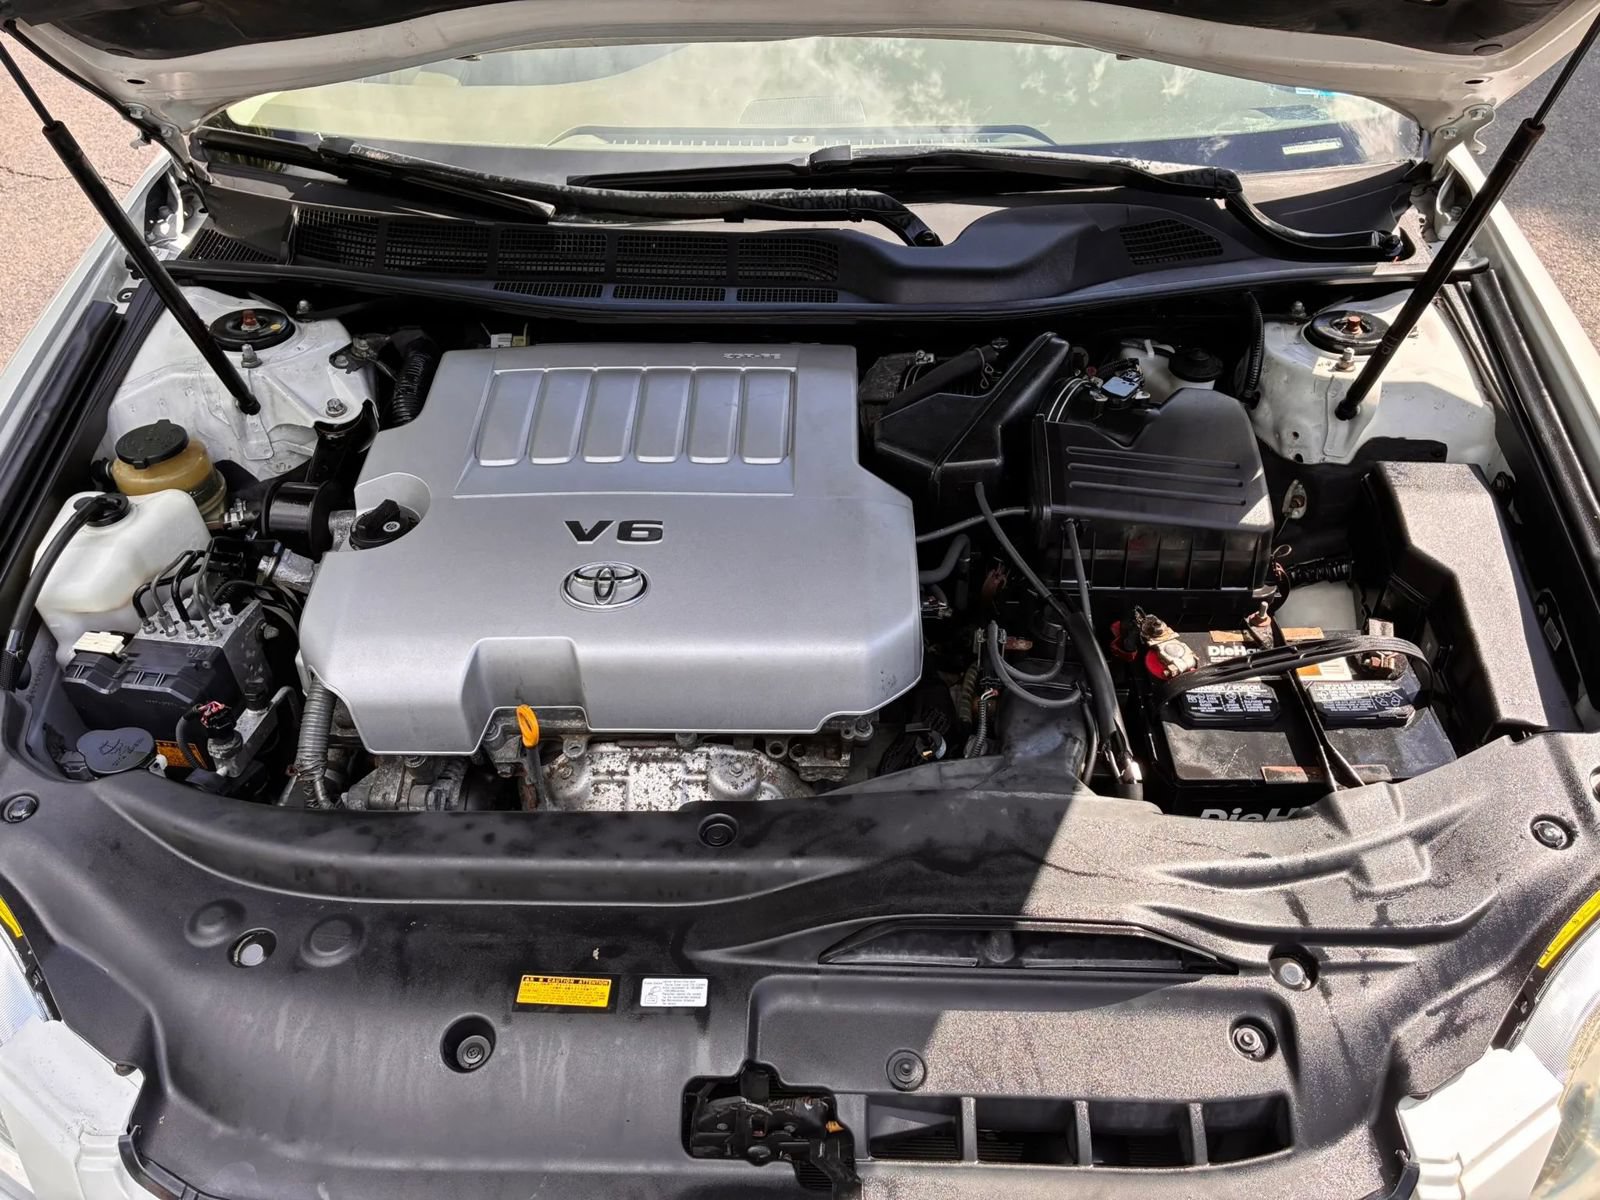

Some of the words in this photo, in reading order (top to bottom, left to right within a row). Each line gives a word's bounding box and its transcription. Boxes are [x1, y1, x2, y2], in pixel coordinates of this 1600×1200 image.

[564, 520, 664, 544] V6
[1208, 645, 1260, 657] DieHa
[1201, 807, 1300, 823] DieH
